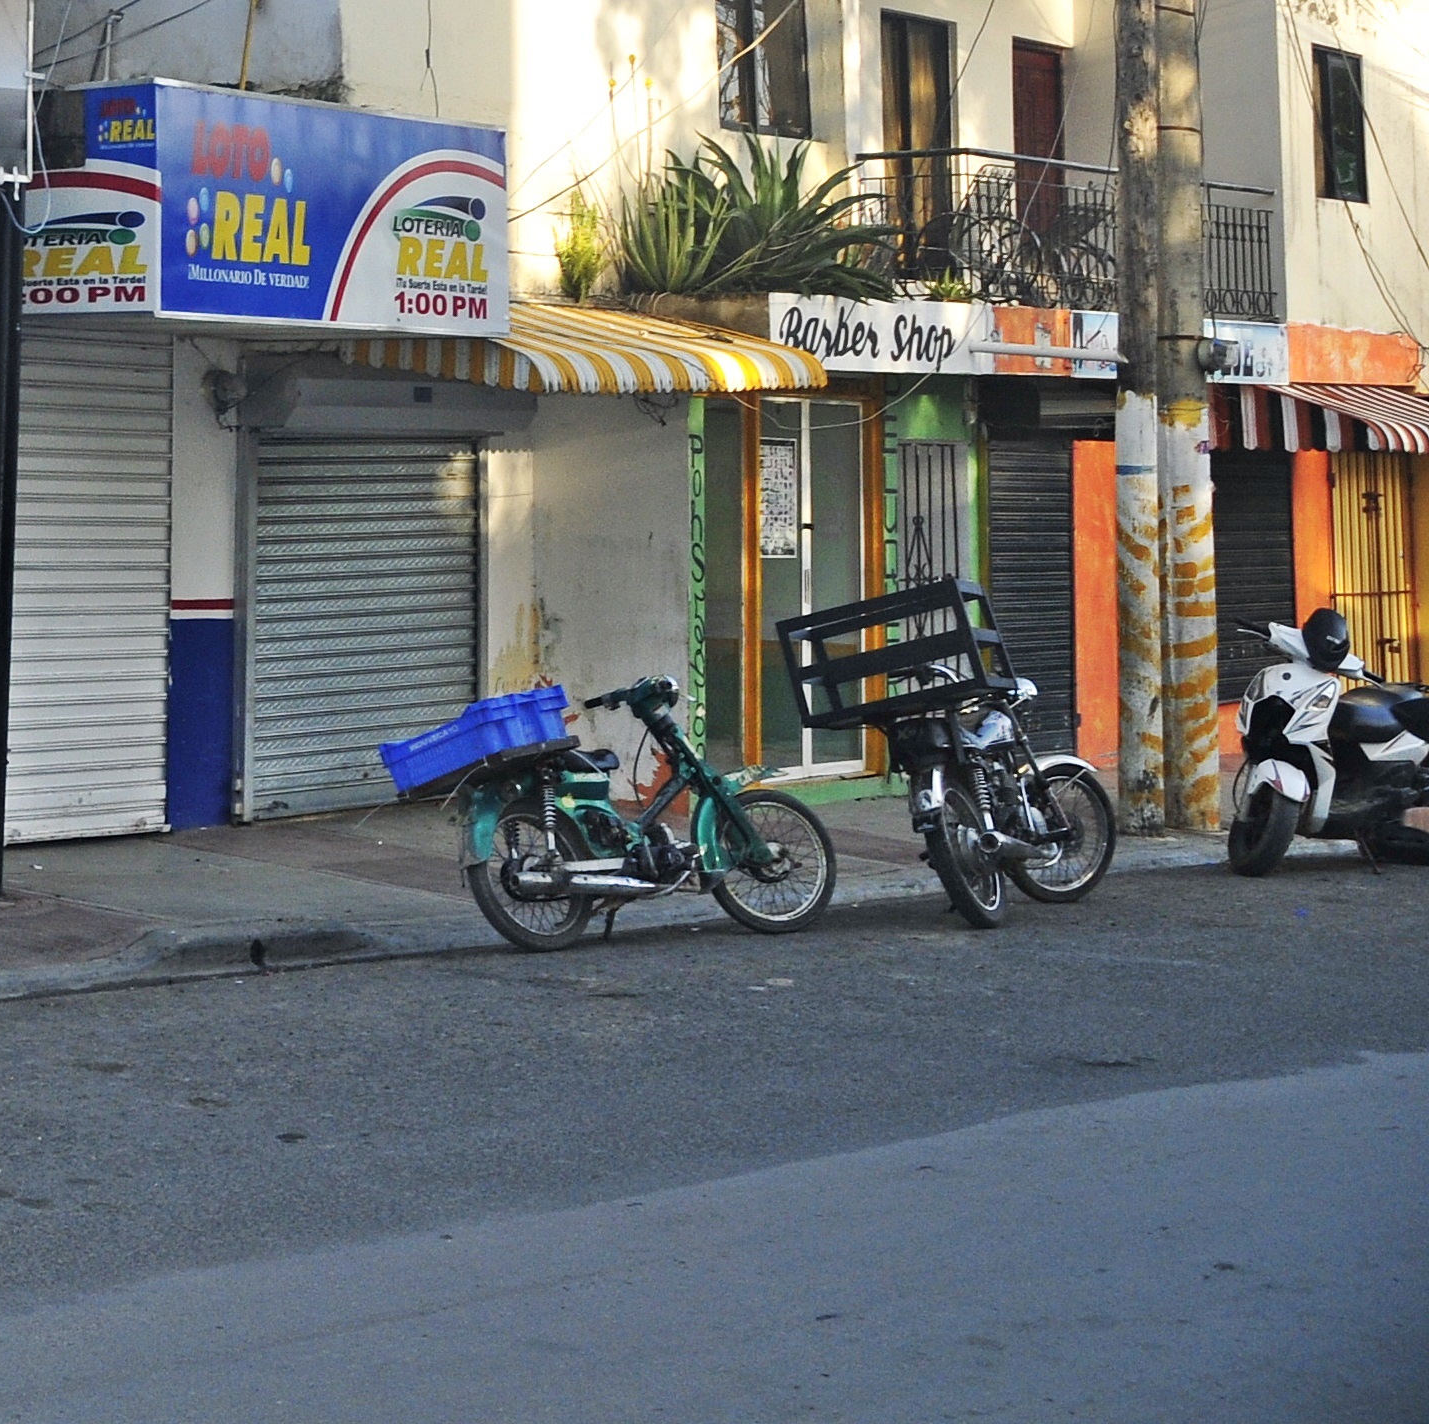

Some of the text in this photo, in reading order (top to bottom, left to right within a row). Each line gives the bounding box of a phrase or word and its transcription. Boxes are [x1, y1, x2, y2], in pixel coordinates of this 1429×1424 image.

[109, 119, 155, 143] REAL
[192, 120, 271, 182] LOTO
[211, 191, 311, 265] REAL
[393, 215, 461, 238] LOTERIA
[23, 245, 148, 277] REAL
[397, 236, 489, 282] REAL
[23, 278, 53, 287] uerte
[88, 286, 146, 303] PM
[395, 291, 488, 320] 1:00 PM
[779, 306, 957, 372] Barber Shop
